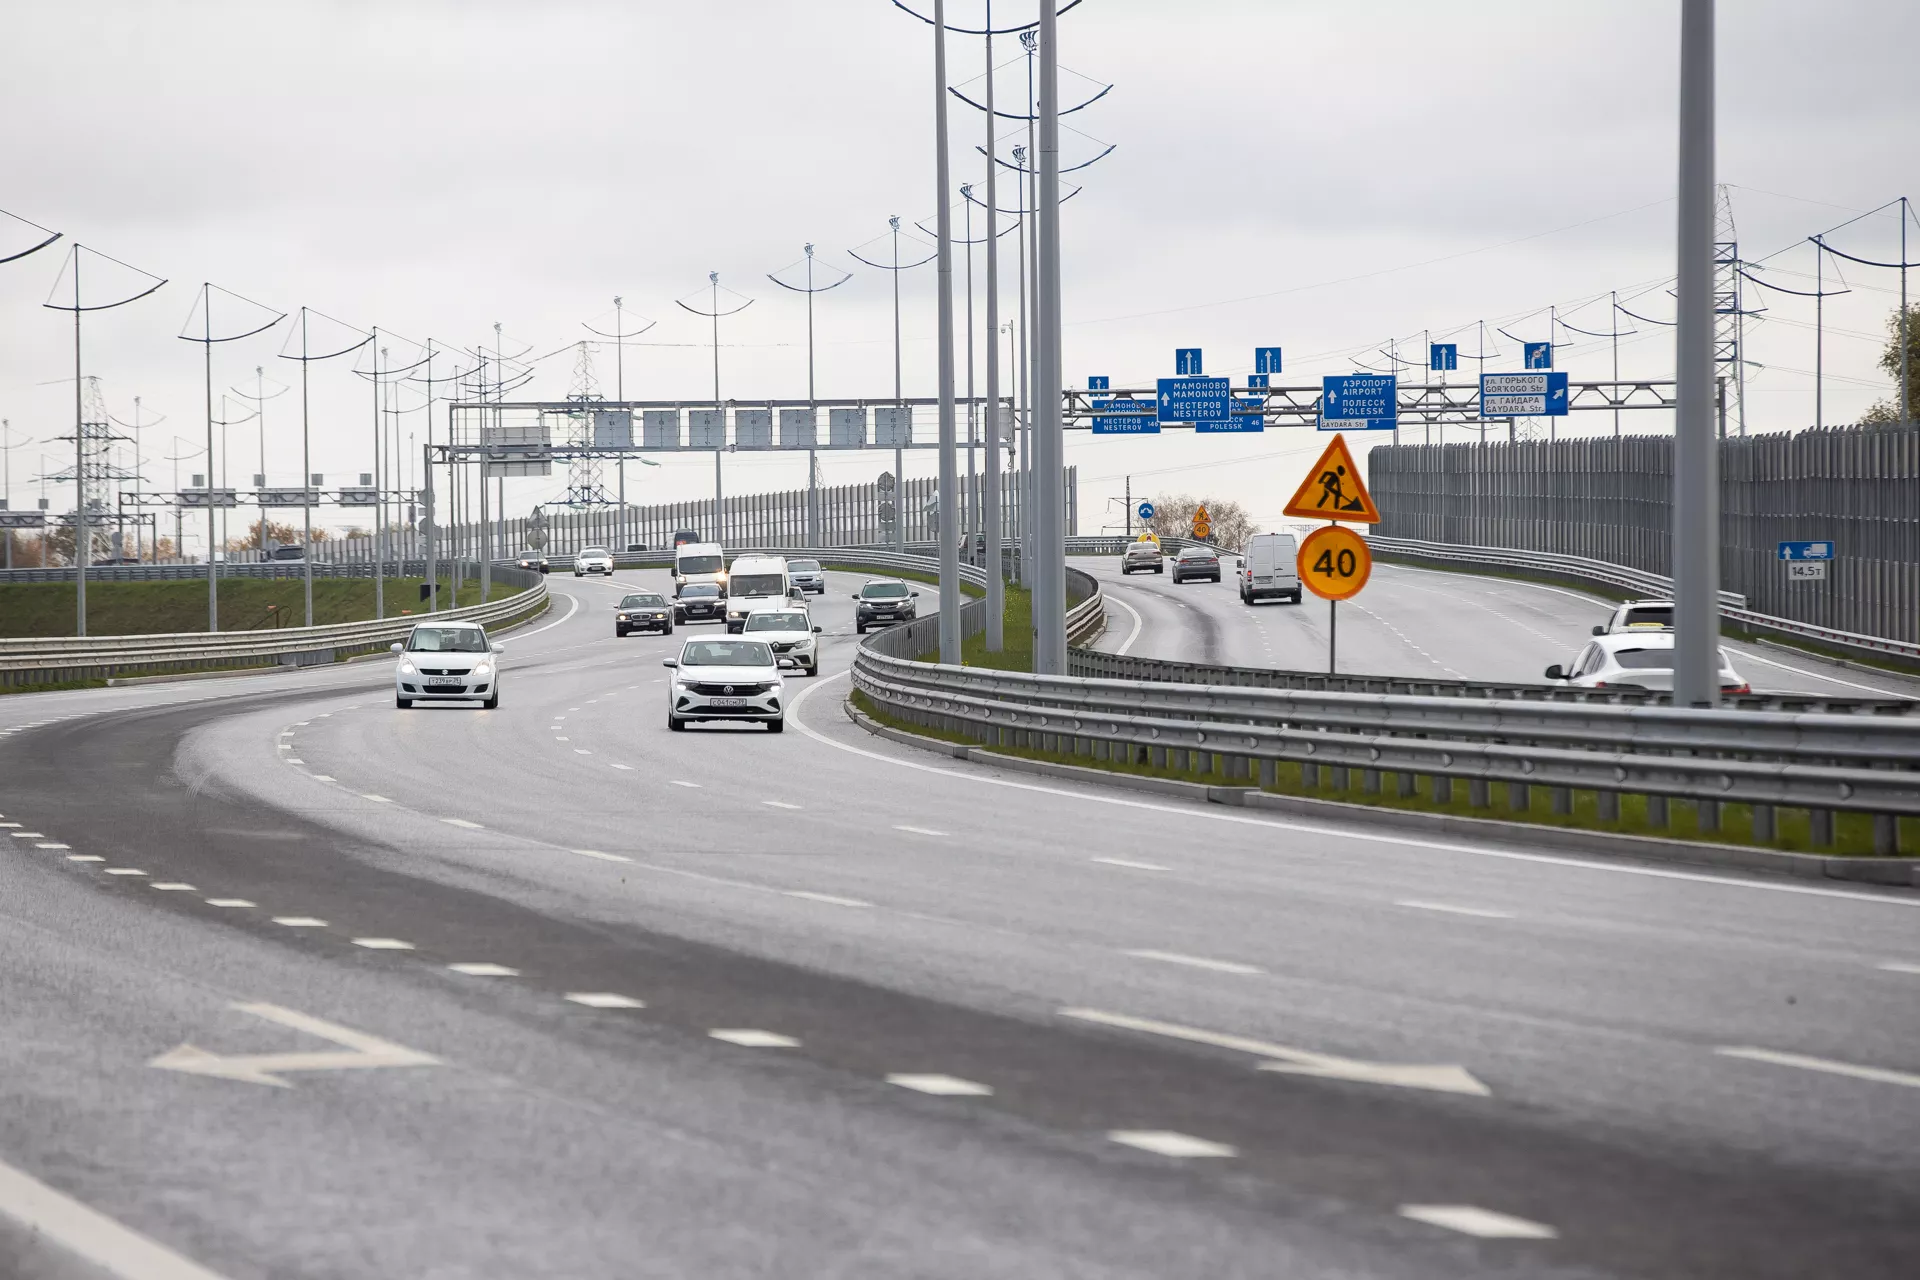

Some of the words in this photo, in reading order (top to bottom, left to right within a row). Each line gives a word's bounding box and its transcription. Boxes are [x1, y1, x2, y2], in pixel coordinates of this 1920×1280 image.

[1342, 379, 1392, 388] АЭРОПОРТ
[1500, 376, 1544, 384] ГОРЬКОГО
[1173, 382, 1227, 390] МАМОНОВО
[1173, 390, 1227, 399] MAMONOVO
[1342, 388, 1383, 396] AIRPORT
[1342, 399, 1386, 407] ПОЛЕССК
[1500, 396, 1540, 404] ГАЙДАРА
[1173, 401, 1221, 410] НЕСТЕРОВ
[1485, 405, 1526, 413] GAYDARA
[1173, 409, 1222, 418] NESTEROV
[1342, 407, 1384, 415] POLESSK
[1313, 548, 1357, 578] 40
